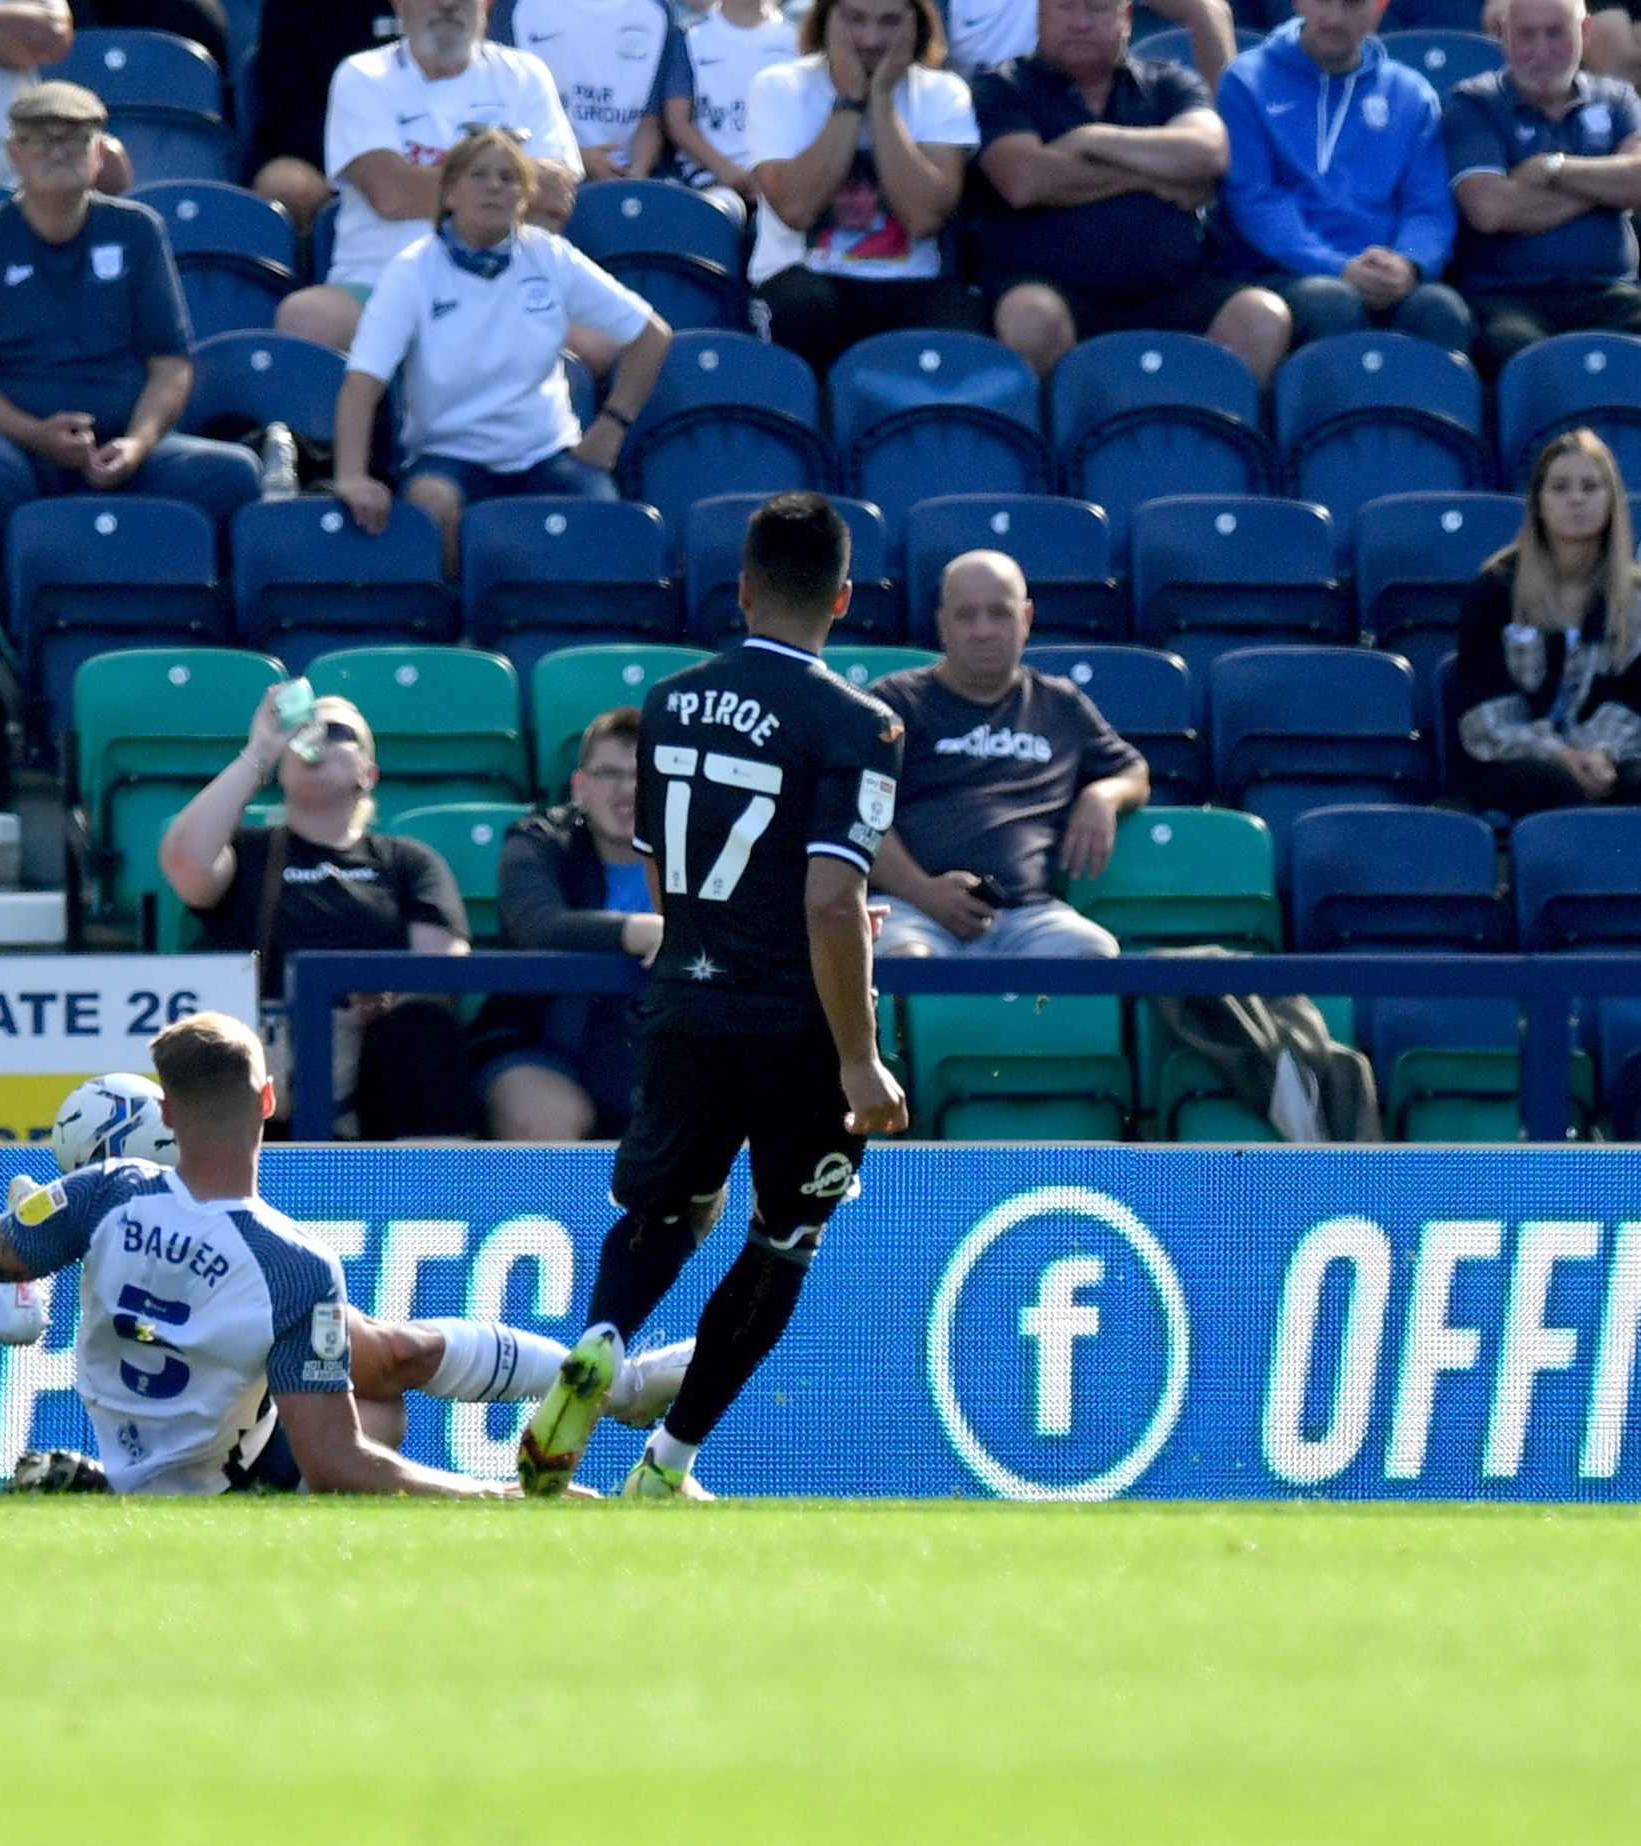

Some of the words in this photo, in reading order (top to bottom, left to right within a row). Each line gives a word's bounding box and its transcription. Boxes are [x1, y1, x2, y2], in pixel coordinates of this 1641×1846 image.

[678, 689, 781, 747] PIROE
[654, 744, 784, 901] 17
[122, 1219, 230, 1289] BAUER
[112, 1284, 192, 1400] 5
